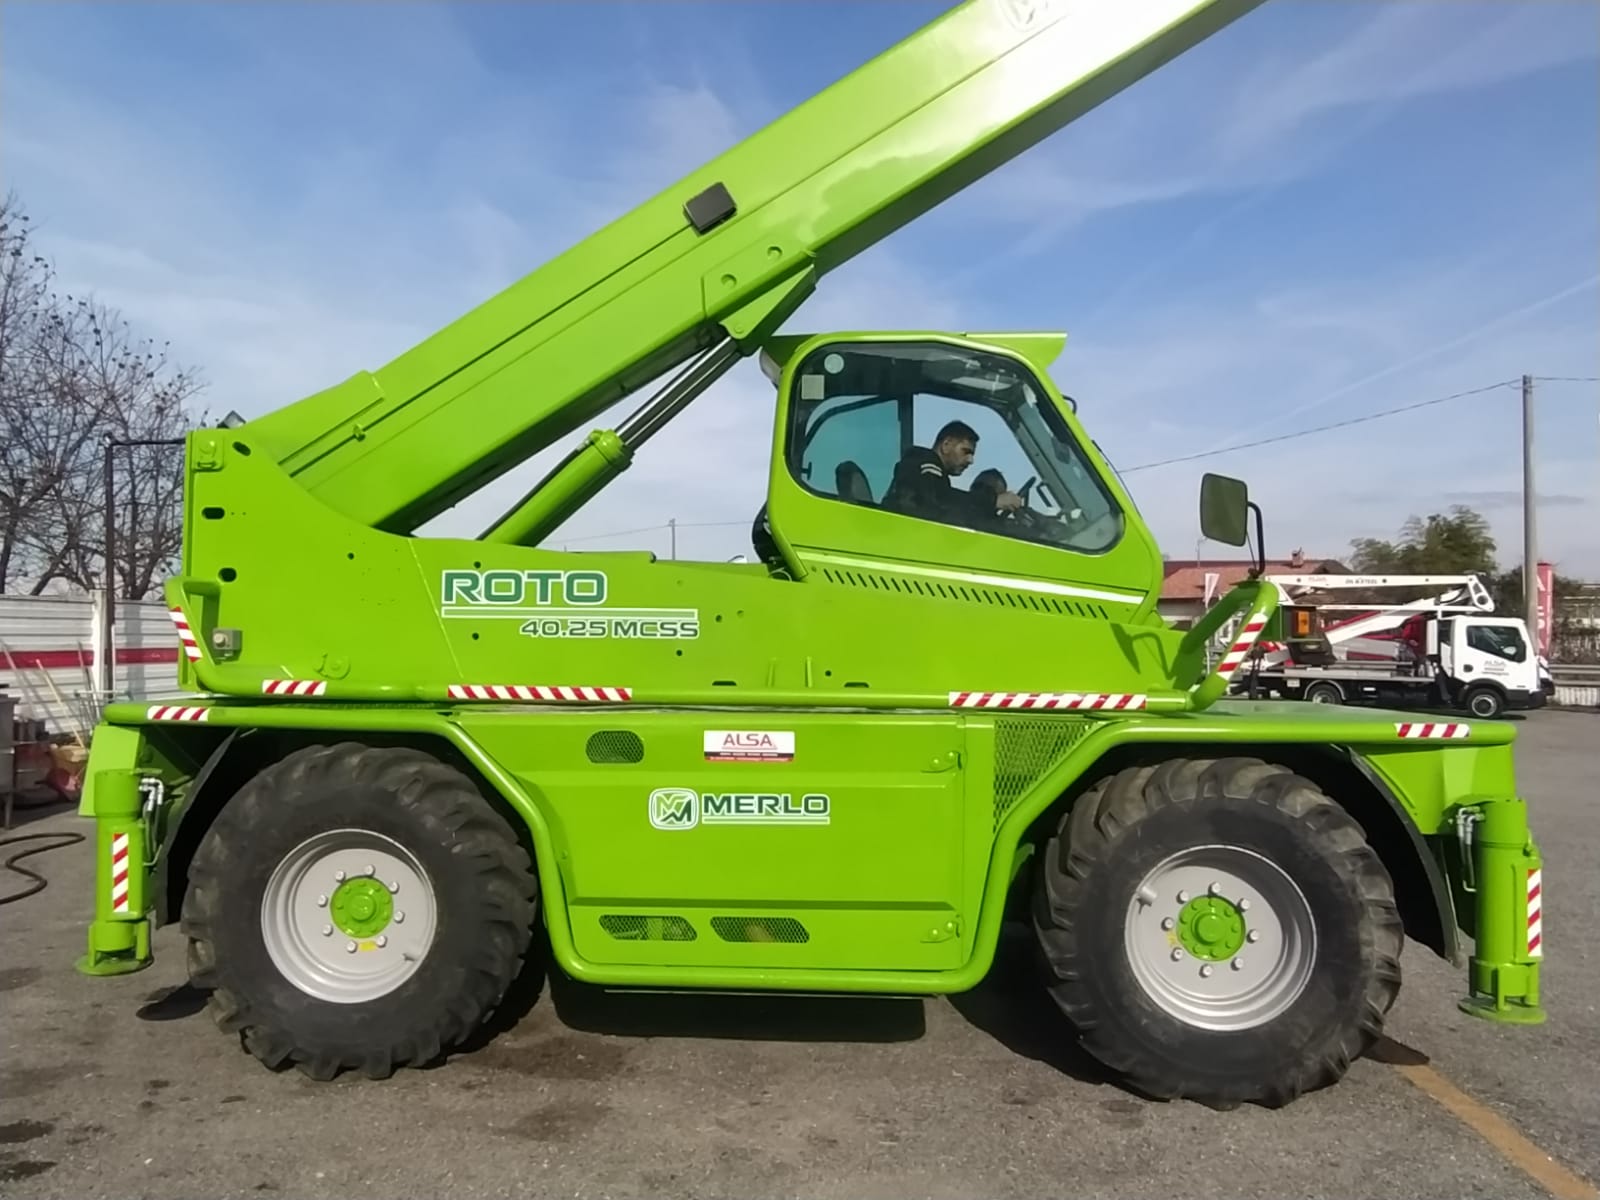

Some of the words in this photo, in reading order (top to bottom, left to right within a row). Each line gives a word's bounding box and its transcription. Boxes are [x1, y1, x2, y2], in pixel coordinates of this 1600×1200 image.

[442, 570, 608, 605] ROTO
[520, 619, 607, 638] 40.25
[612, 620, 700, 639] MCSS
[723, 733, 773, 747] ALSA
[702, 793, 831, 815] MERLO
